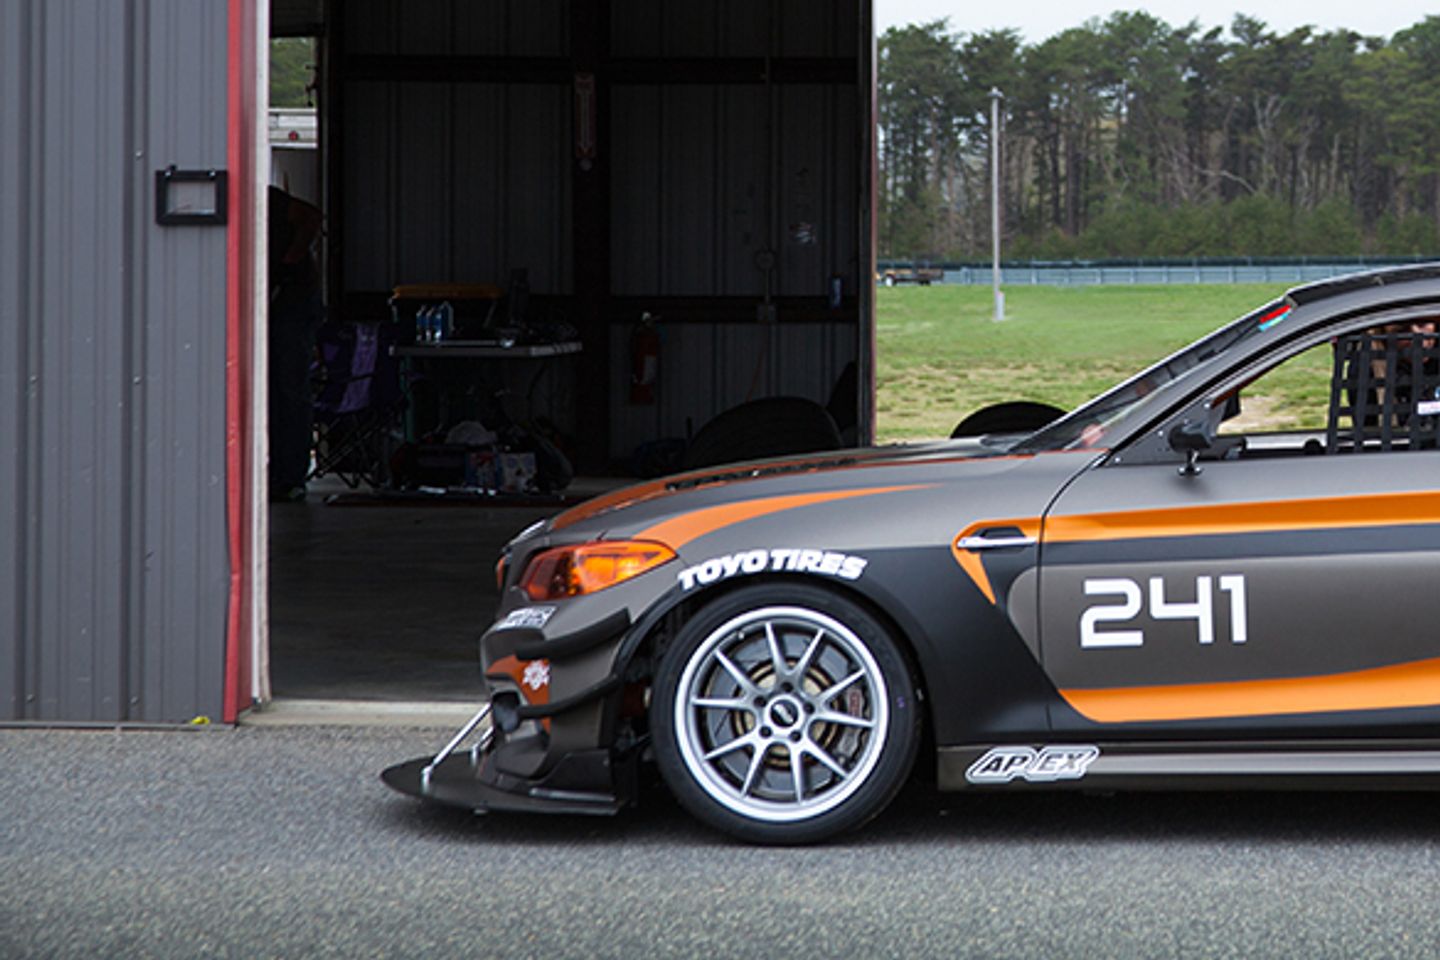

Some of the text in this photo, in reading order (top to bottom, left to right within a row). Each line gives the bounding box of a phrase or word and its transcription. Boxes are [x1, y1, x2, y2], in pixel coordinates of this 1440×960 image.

[677, 548, 868, 591] TOYO TIRES
[1080, 575, 1247, 648] 241
[972, 748, 1093, 778] APEX
